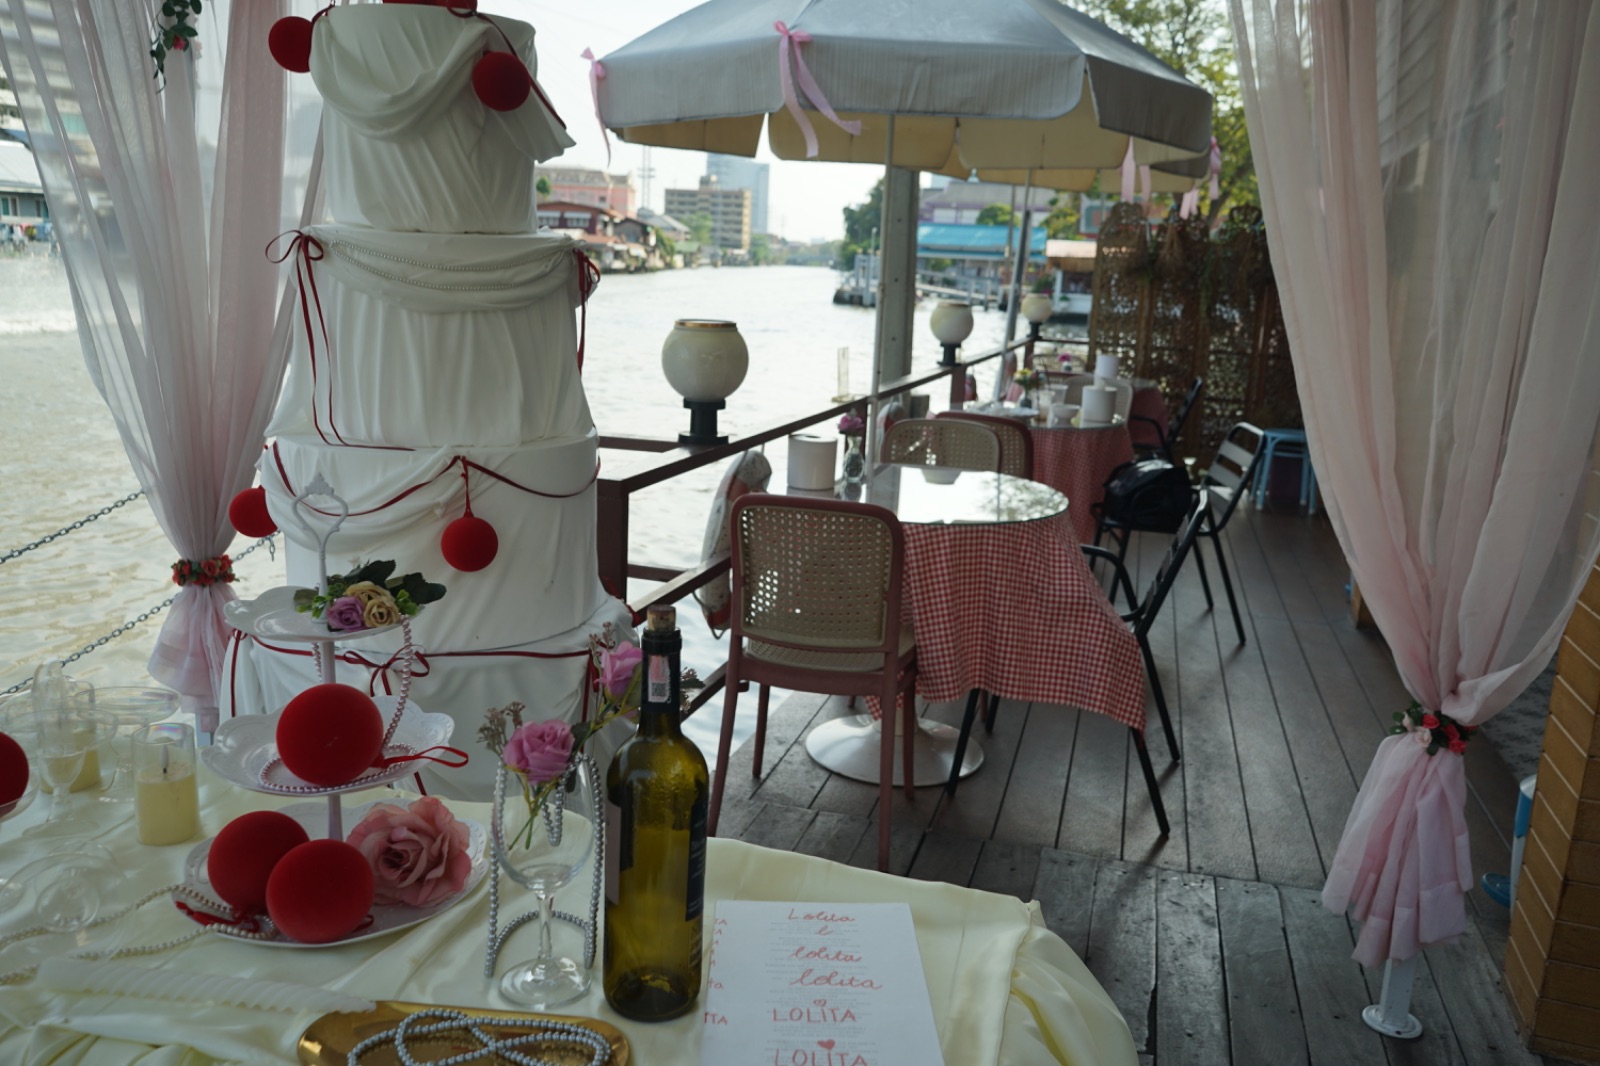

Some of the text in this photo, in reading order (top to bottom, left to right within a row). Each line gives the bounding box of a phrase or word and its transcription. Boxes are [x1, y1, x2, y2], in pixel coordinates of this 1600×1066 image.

[789, 946, 862, 962] lolita
[789, 968, 883, 990] lolita
[773, 1007, 857, 1023] LOLITA
[774, 1047, 868, 1066] LOLITA
